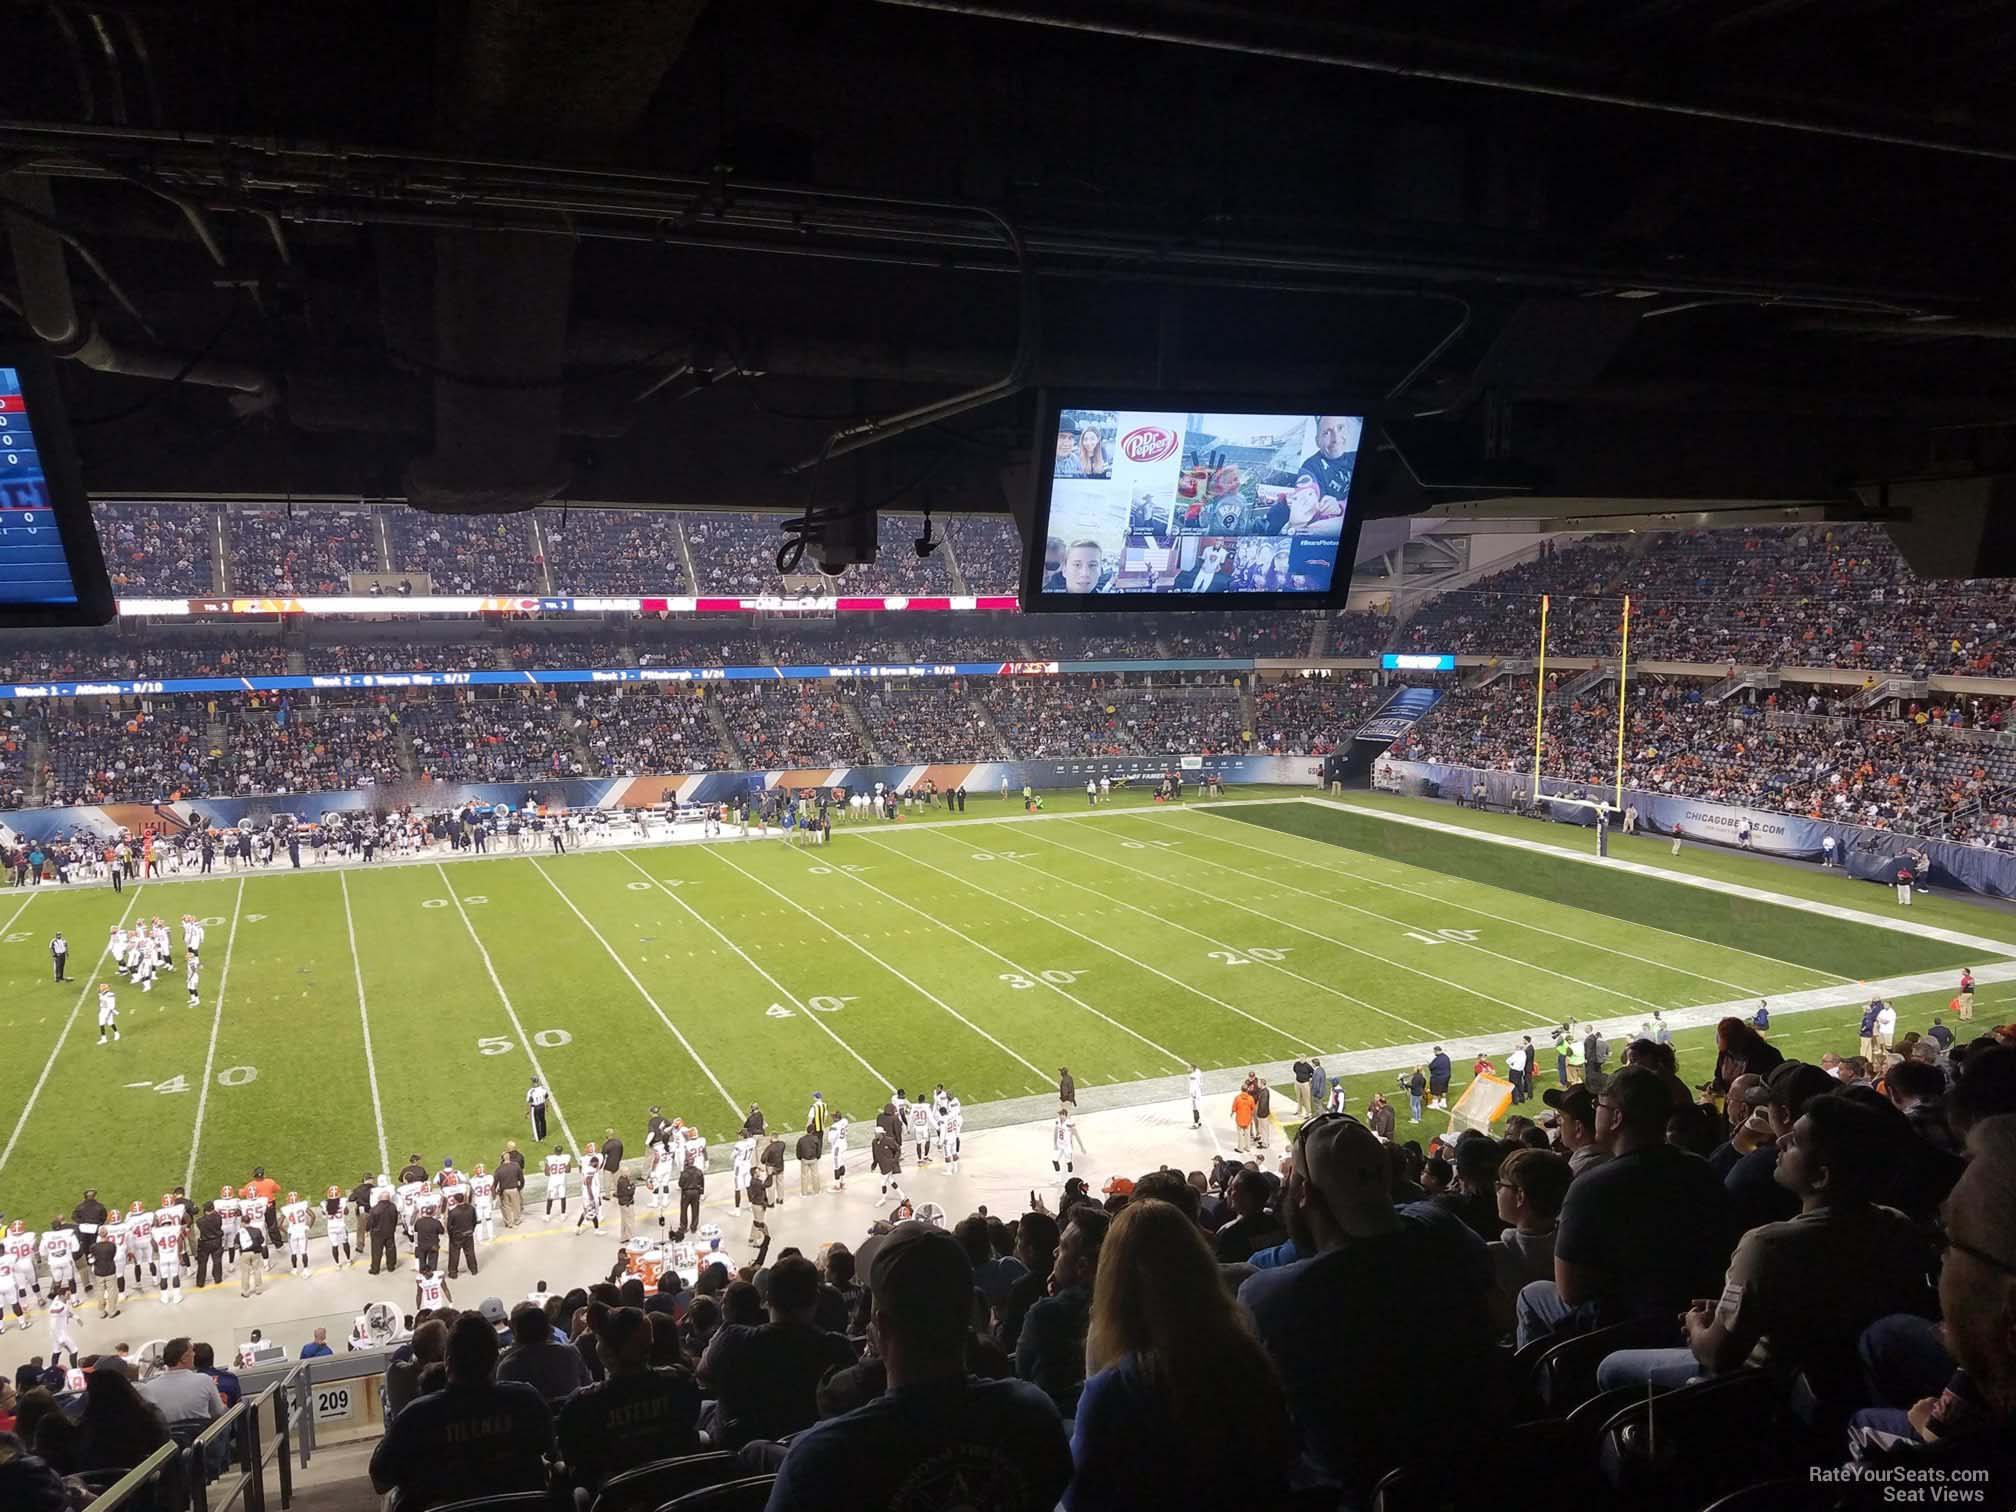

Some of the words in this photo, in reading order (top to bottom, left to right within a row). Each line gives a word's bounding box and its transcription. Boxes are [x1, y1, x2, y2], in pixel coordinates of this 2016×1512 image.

[2, 434, 13, 446] 0
[1143, 431, 1160, 446] Dr
[1128, 434, 1169, 458] Pepper
[7, 453, 18, 465] 0
[24, 512, 34, 522] 0
[592, 671, 618, 681] Week
[640, 670, 692, 681] Pittsburgh
[829, 667, 854, 677] Week
[880, 666, 907, 676] Green
[908, 666, 926, 677] Bay
[312, 676, 342, 687] Week
[376, 675, 410, 686] Tampa
[412, 674, 433, 686] Bay
[15, 686, 48, 697] Week
[75, 684, 120, 696] Atlanta
[1685, 810, 1785, 836] CHICAGOBES.COM
[425, 1287, 439, 1301] 16
[318, 1389, 349, 1411] 209
